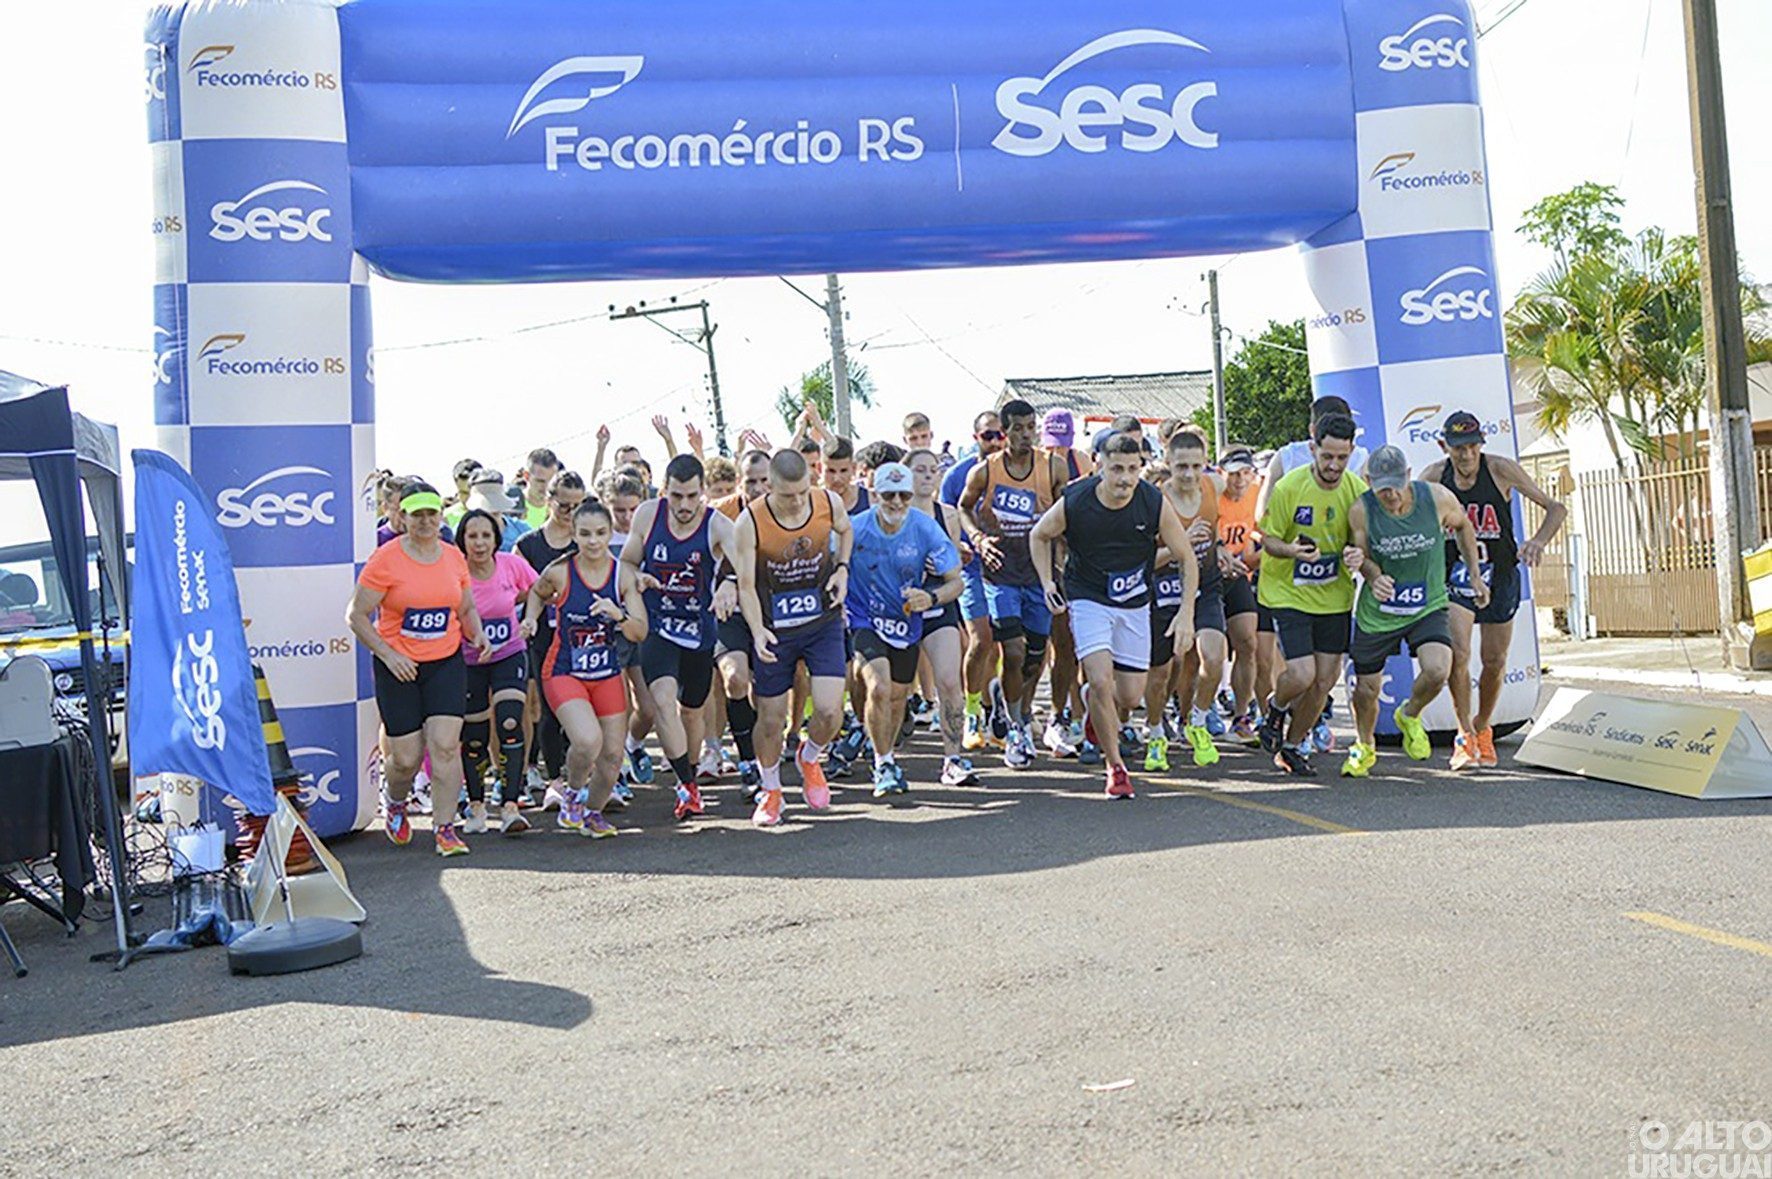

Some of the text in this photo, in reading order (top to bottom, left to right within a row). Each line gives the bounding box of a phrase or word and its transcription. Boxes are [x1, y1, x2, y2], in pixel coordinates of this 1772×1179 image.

[1378, 35, 1470, 72] Sesc
[198, 69, 337, 90] Fecomércio RS
[991, 76, 1219, 155] Sesc
[545, 117, 924, 171] Fecomércio RS
[1381, 169, 1484, 191] Fecomércio RS
[165, 215, 182, 232] RS
[209, 201, 332, 242] Sesc
[1344, 308, 1366, 324] RS
[1400, 288, 1493, 325] Sesc
[208, 357, 318, 374] Fecomércio
[324, 357, 345, 374] RS
[216, 488, 335, 528] Sesc
[997, 491, 1031, 511] 159
[1224, 526, 1245, 545] JR
[173, 500, 193, 614] Fecomércio
[1299, 562, 1334, 577] 001
[1456, 567, 1490, 583] 14
[1159, 579, 1182, 595] 05
[777, 594, 816, 614] 129
[410, 612, 446, 628] 189
[662, 616, 698, 635] 174
[484, 624, 508, 639] 00
[248, 637, 350, 658] omércio RS
[578, 650, 609, 670] 191
[188, 630, 226, 751] Sesc
[176, 779, 194, 797] RS
